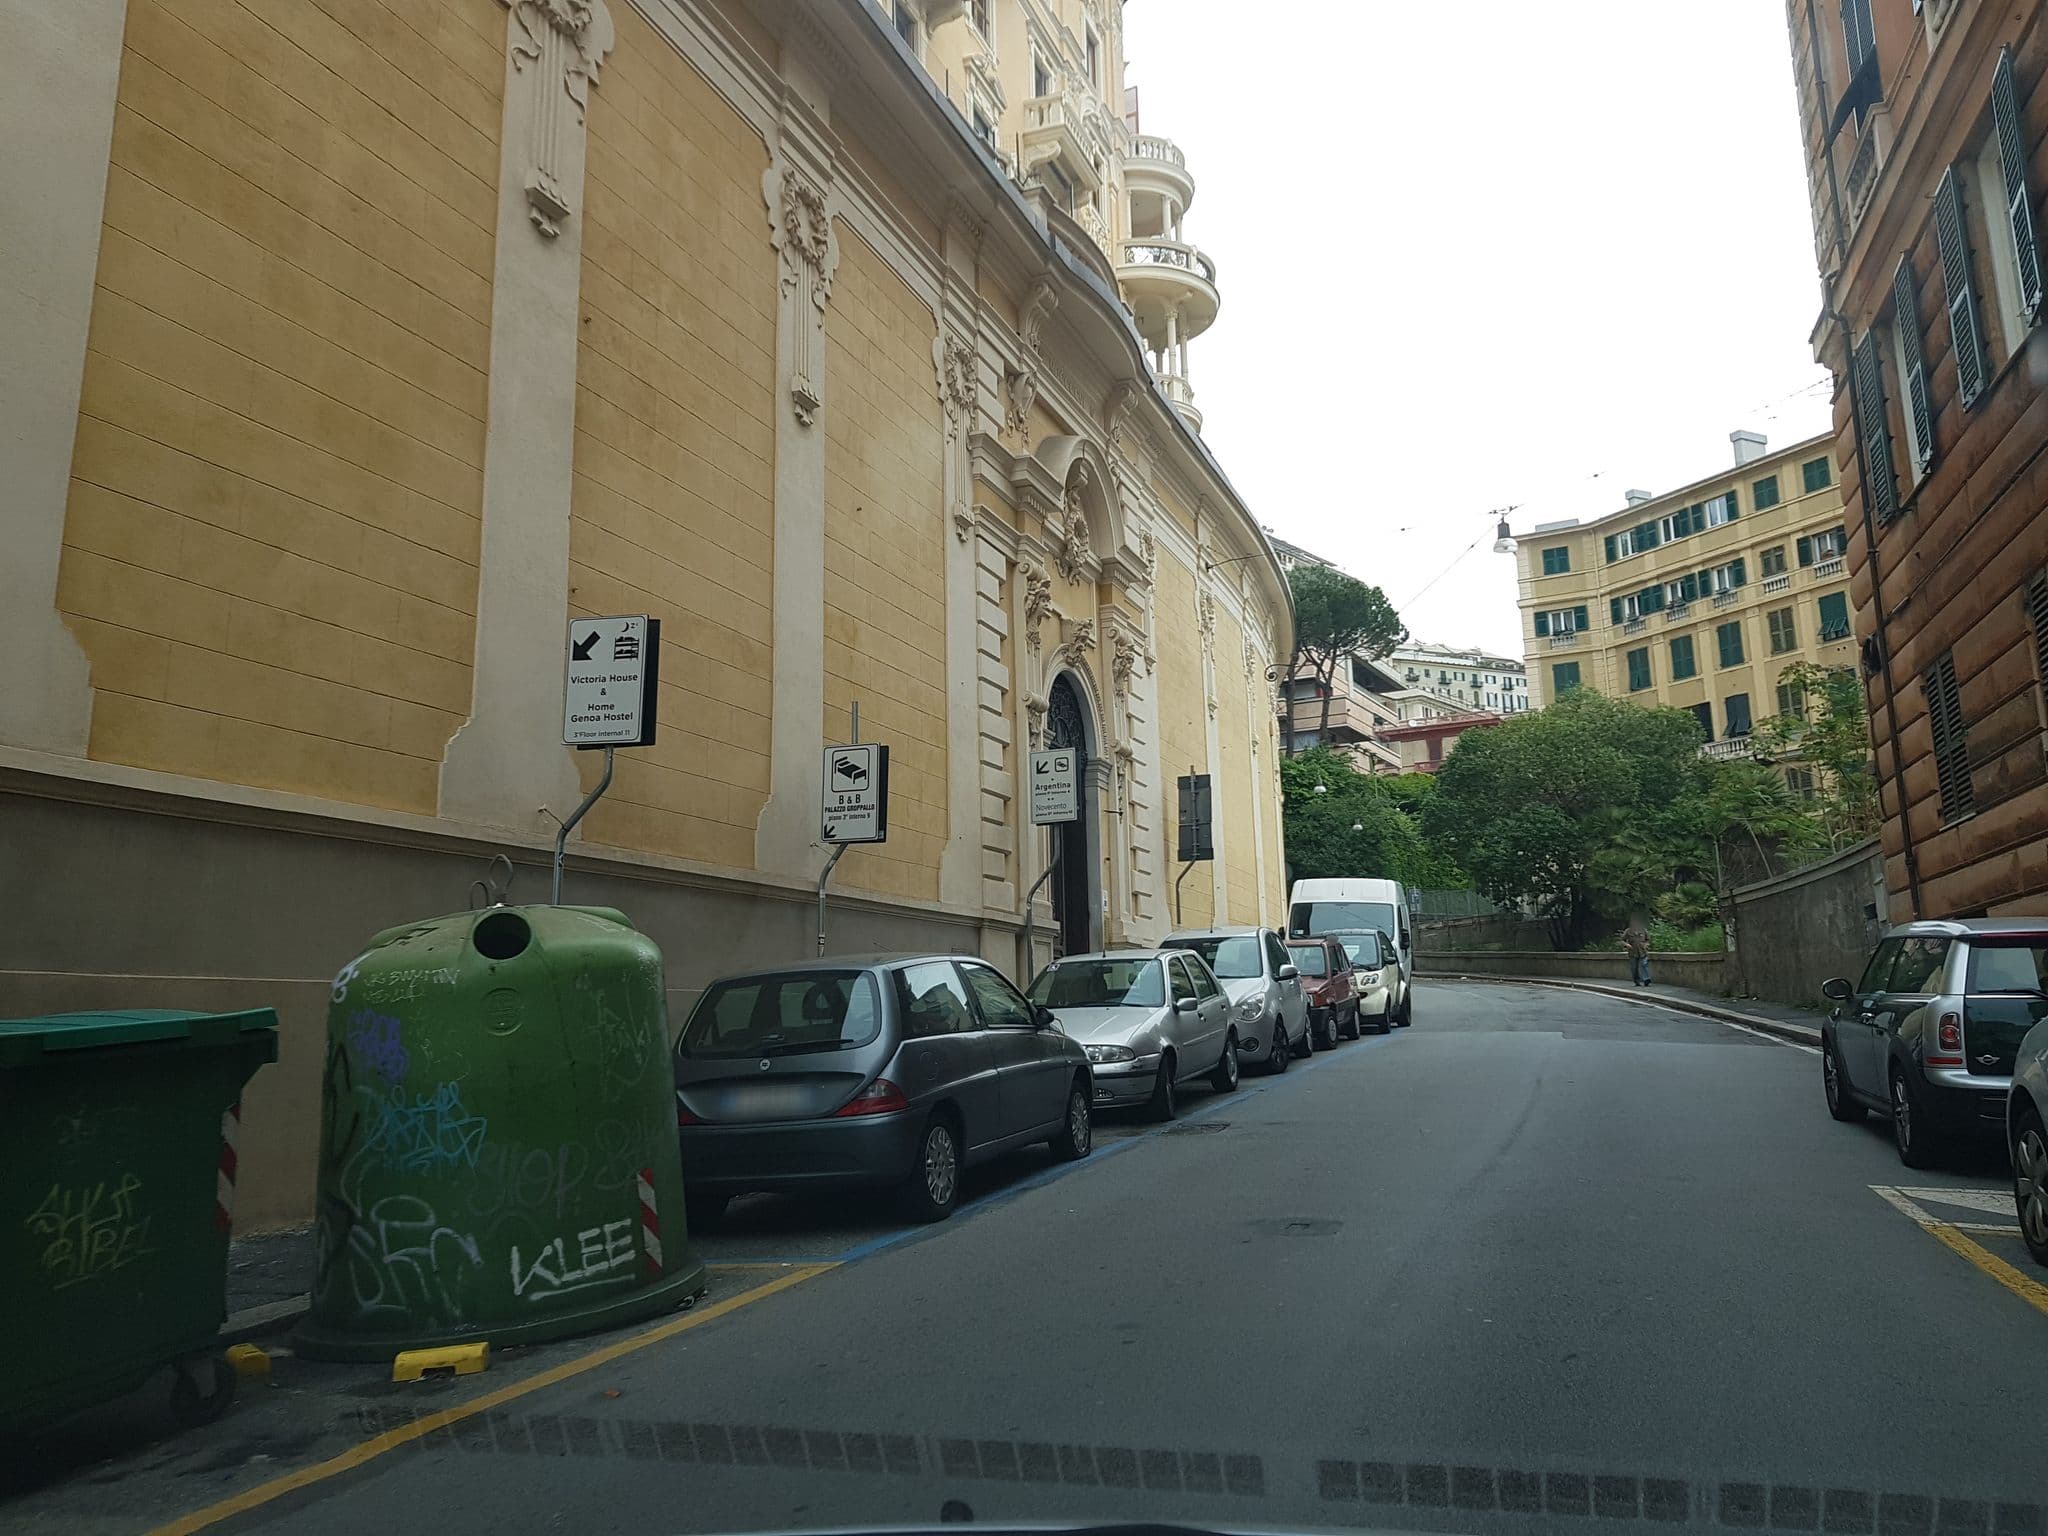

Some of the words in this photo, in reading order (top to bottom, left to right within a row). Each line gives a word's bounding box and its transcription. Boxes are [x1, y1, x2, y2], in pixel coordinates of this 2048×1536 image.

[571, 675, 606, 684] Victoria
[609, 674, 638, 682] House
[600, 688, 606, 696] &
[587, 703, 615, 711] Home
[570, 714, 600, 722] Genoa
[604, 712, 633, 721] Hostel
[1035, 782, 1071, 791] Argentina
[839, 795, 844, 805] B
[847, 796, 852, 804] &
[856, 794, 861, 803] B
[512, 1217, 635, 1296] KLEE
